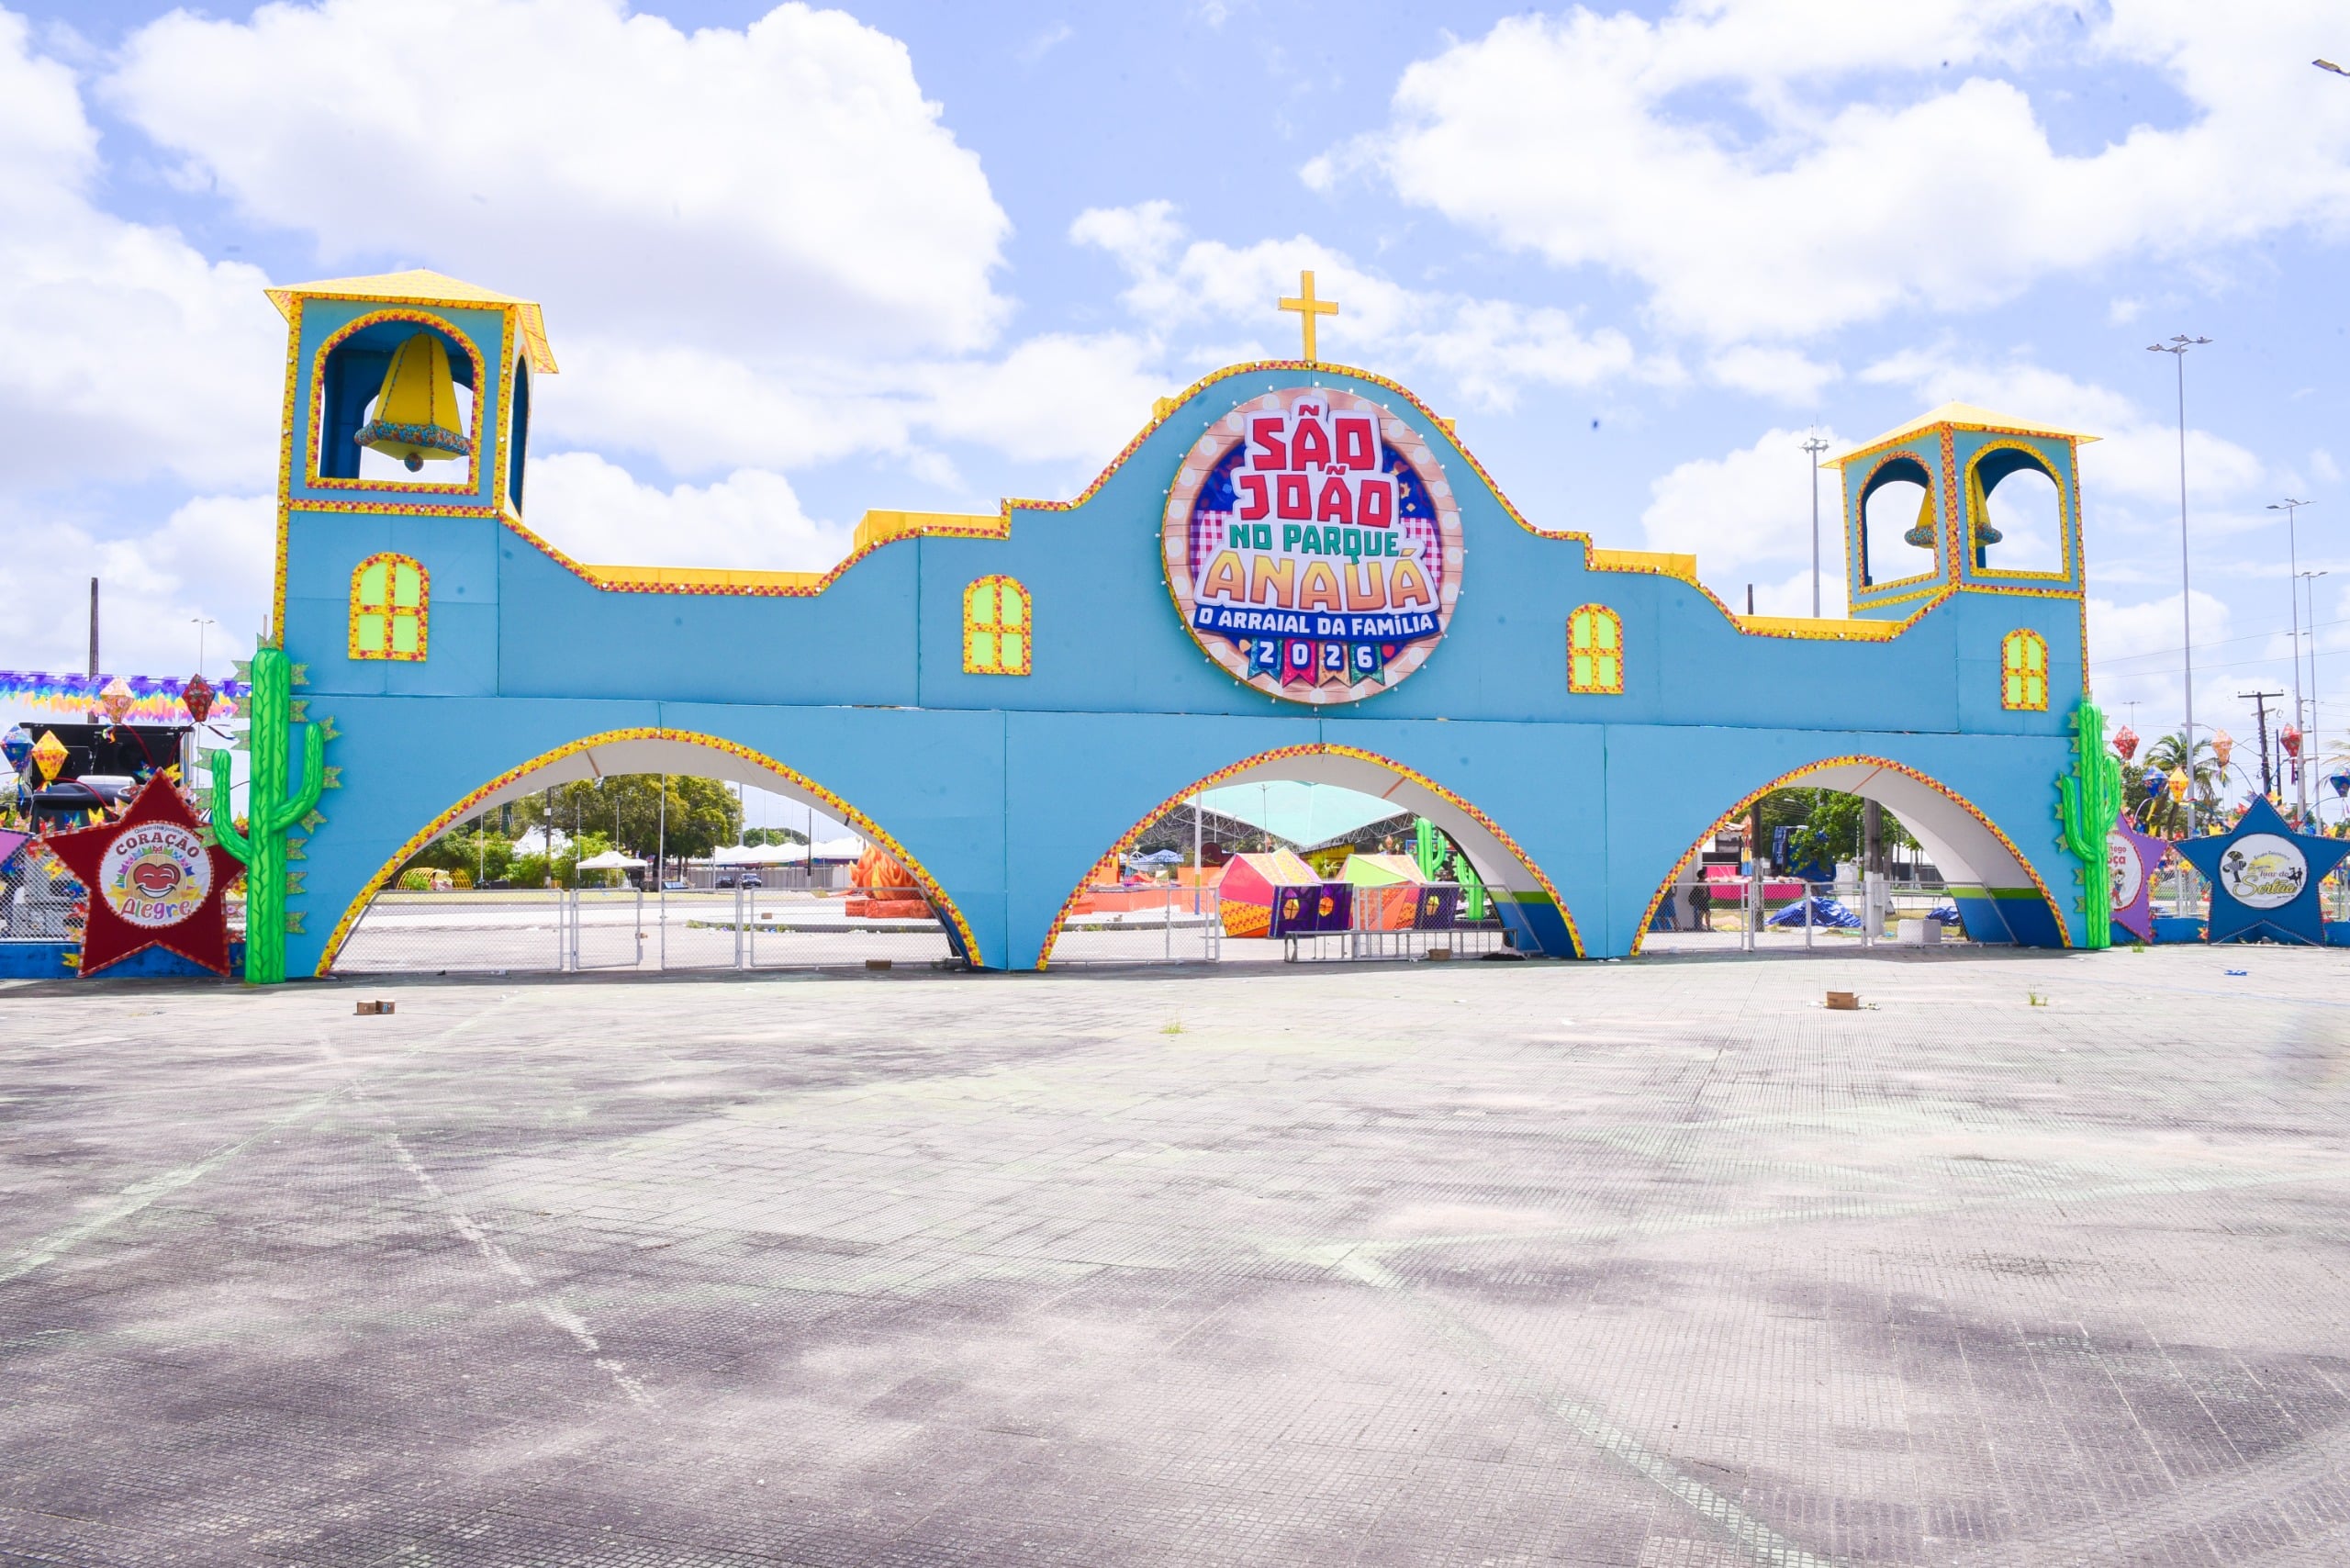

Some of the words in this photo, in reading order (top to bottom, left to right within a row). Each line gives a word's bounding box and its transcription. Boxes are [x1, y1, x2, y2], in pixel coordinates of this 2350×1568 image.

[1252, 404, 1375, 471] SÃO
[1239, 465, 1392, 528] JOÃO
[1229, 524, 1272, 550] NO
[1283, 524, 1399, 565] PARQUE
[1203, 548, 1431, 611] ANAUÁ
[1198, 608, 1214, 624] O
[1218, 612, 1310, 633] ARRAIAL
[1317, 617, 1346, 635] DA
[1351, 613, 1434, 636] FAMÍLIA
[1259, 642, 1373, 668] 2026
[116, 832, 199, 857] CORAÇÃO
[2232, 874, 2298, 898] Sertão
[121, 898, 192, 920] Alegre
